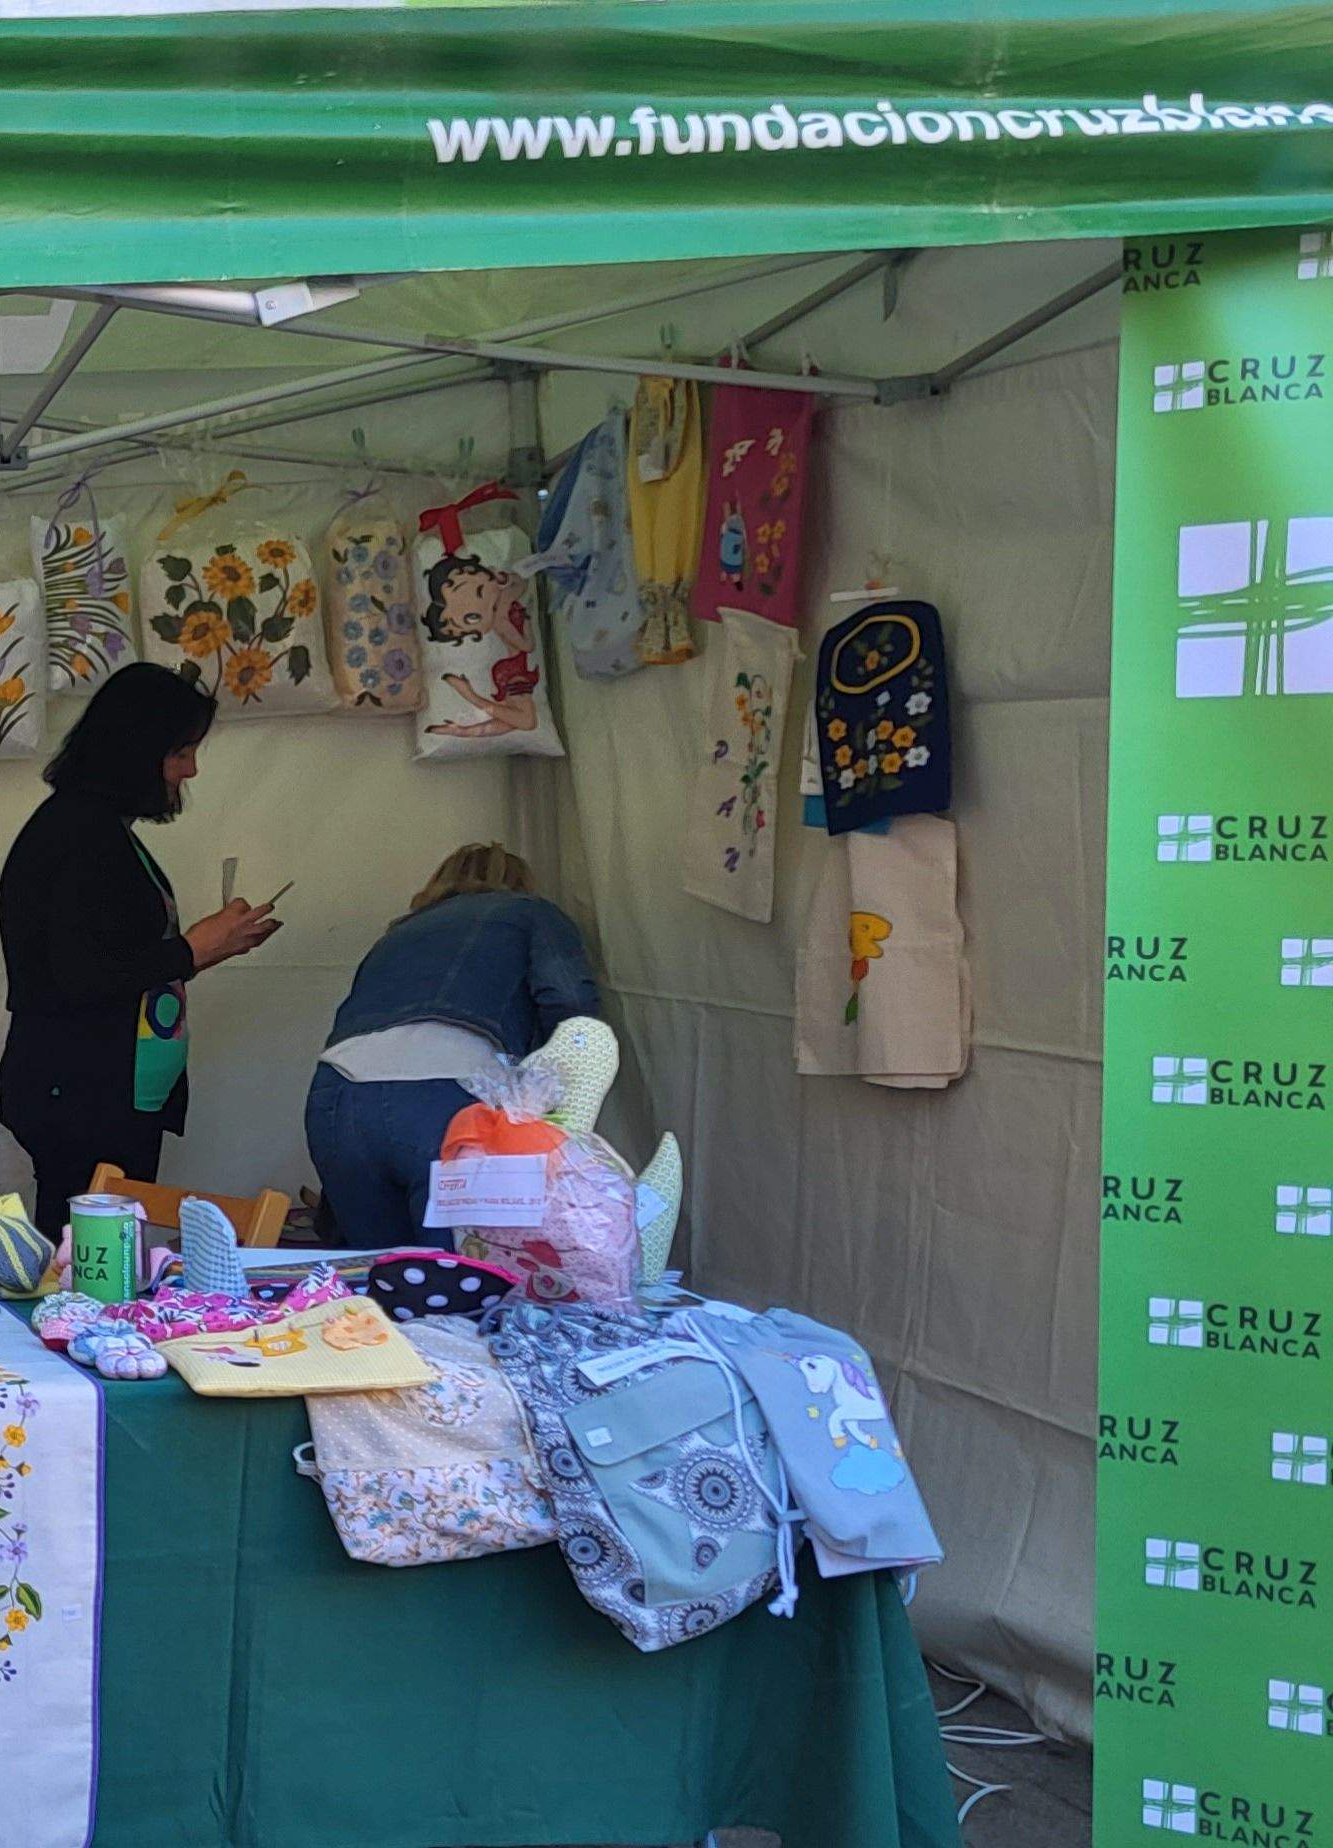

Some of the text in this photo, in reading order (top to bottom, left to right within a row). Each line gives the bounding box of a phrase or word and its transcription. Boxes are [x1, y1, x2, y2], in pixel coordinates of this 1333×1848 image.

[1122, 243, 1204, 271] RUZ
[1122, 269, 1202, 294] ANCA
[1207, 355, 1327, 386] CRUZ
[1206, 382, 1325, 407] BLANCA
[1215, 815, 1327, 840] CRUZ
[1214, 844, 1328, 862] BLANCA
[1107, 936, 1188, 960] RUZ
[1107, 964, 1187, 982] ANCA
[1210, 1060, 1326, 1086] CRUZ
[1209, 1088, 1325, 1110] BLANCA
[1102, 1175, 1183, 1202] RUZ
[1102, 1203, 1183, 1224] ANCA
[76, 1244, 109, 1265] UZ
[73, 1264, 109, 1281] NCA
[1206, 1302, 1322, 1336] CRUZ
[1206, 1331, 1321, 1360] BLANCA
[1098, 1415, 1180, 1444] RUZ
[1098, 1442, 1179, 1467] ANCA
[1202, 1546, 1318, 1585] CRUZ
[1202, 1574, 1317, 1608] BLANCA
[1095, 1652, 1177, 1687] RUZ
[1095, 1682, 1177, 1709] ANCA
[1198, 1791, 1315, 1836] CRUZ
